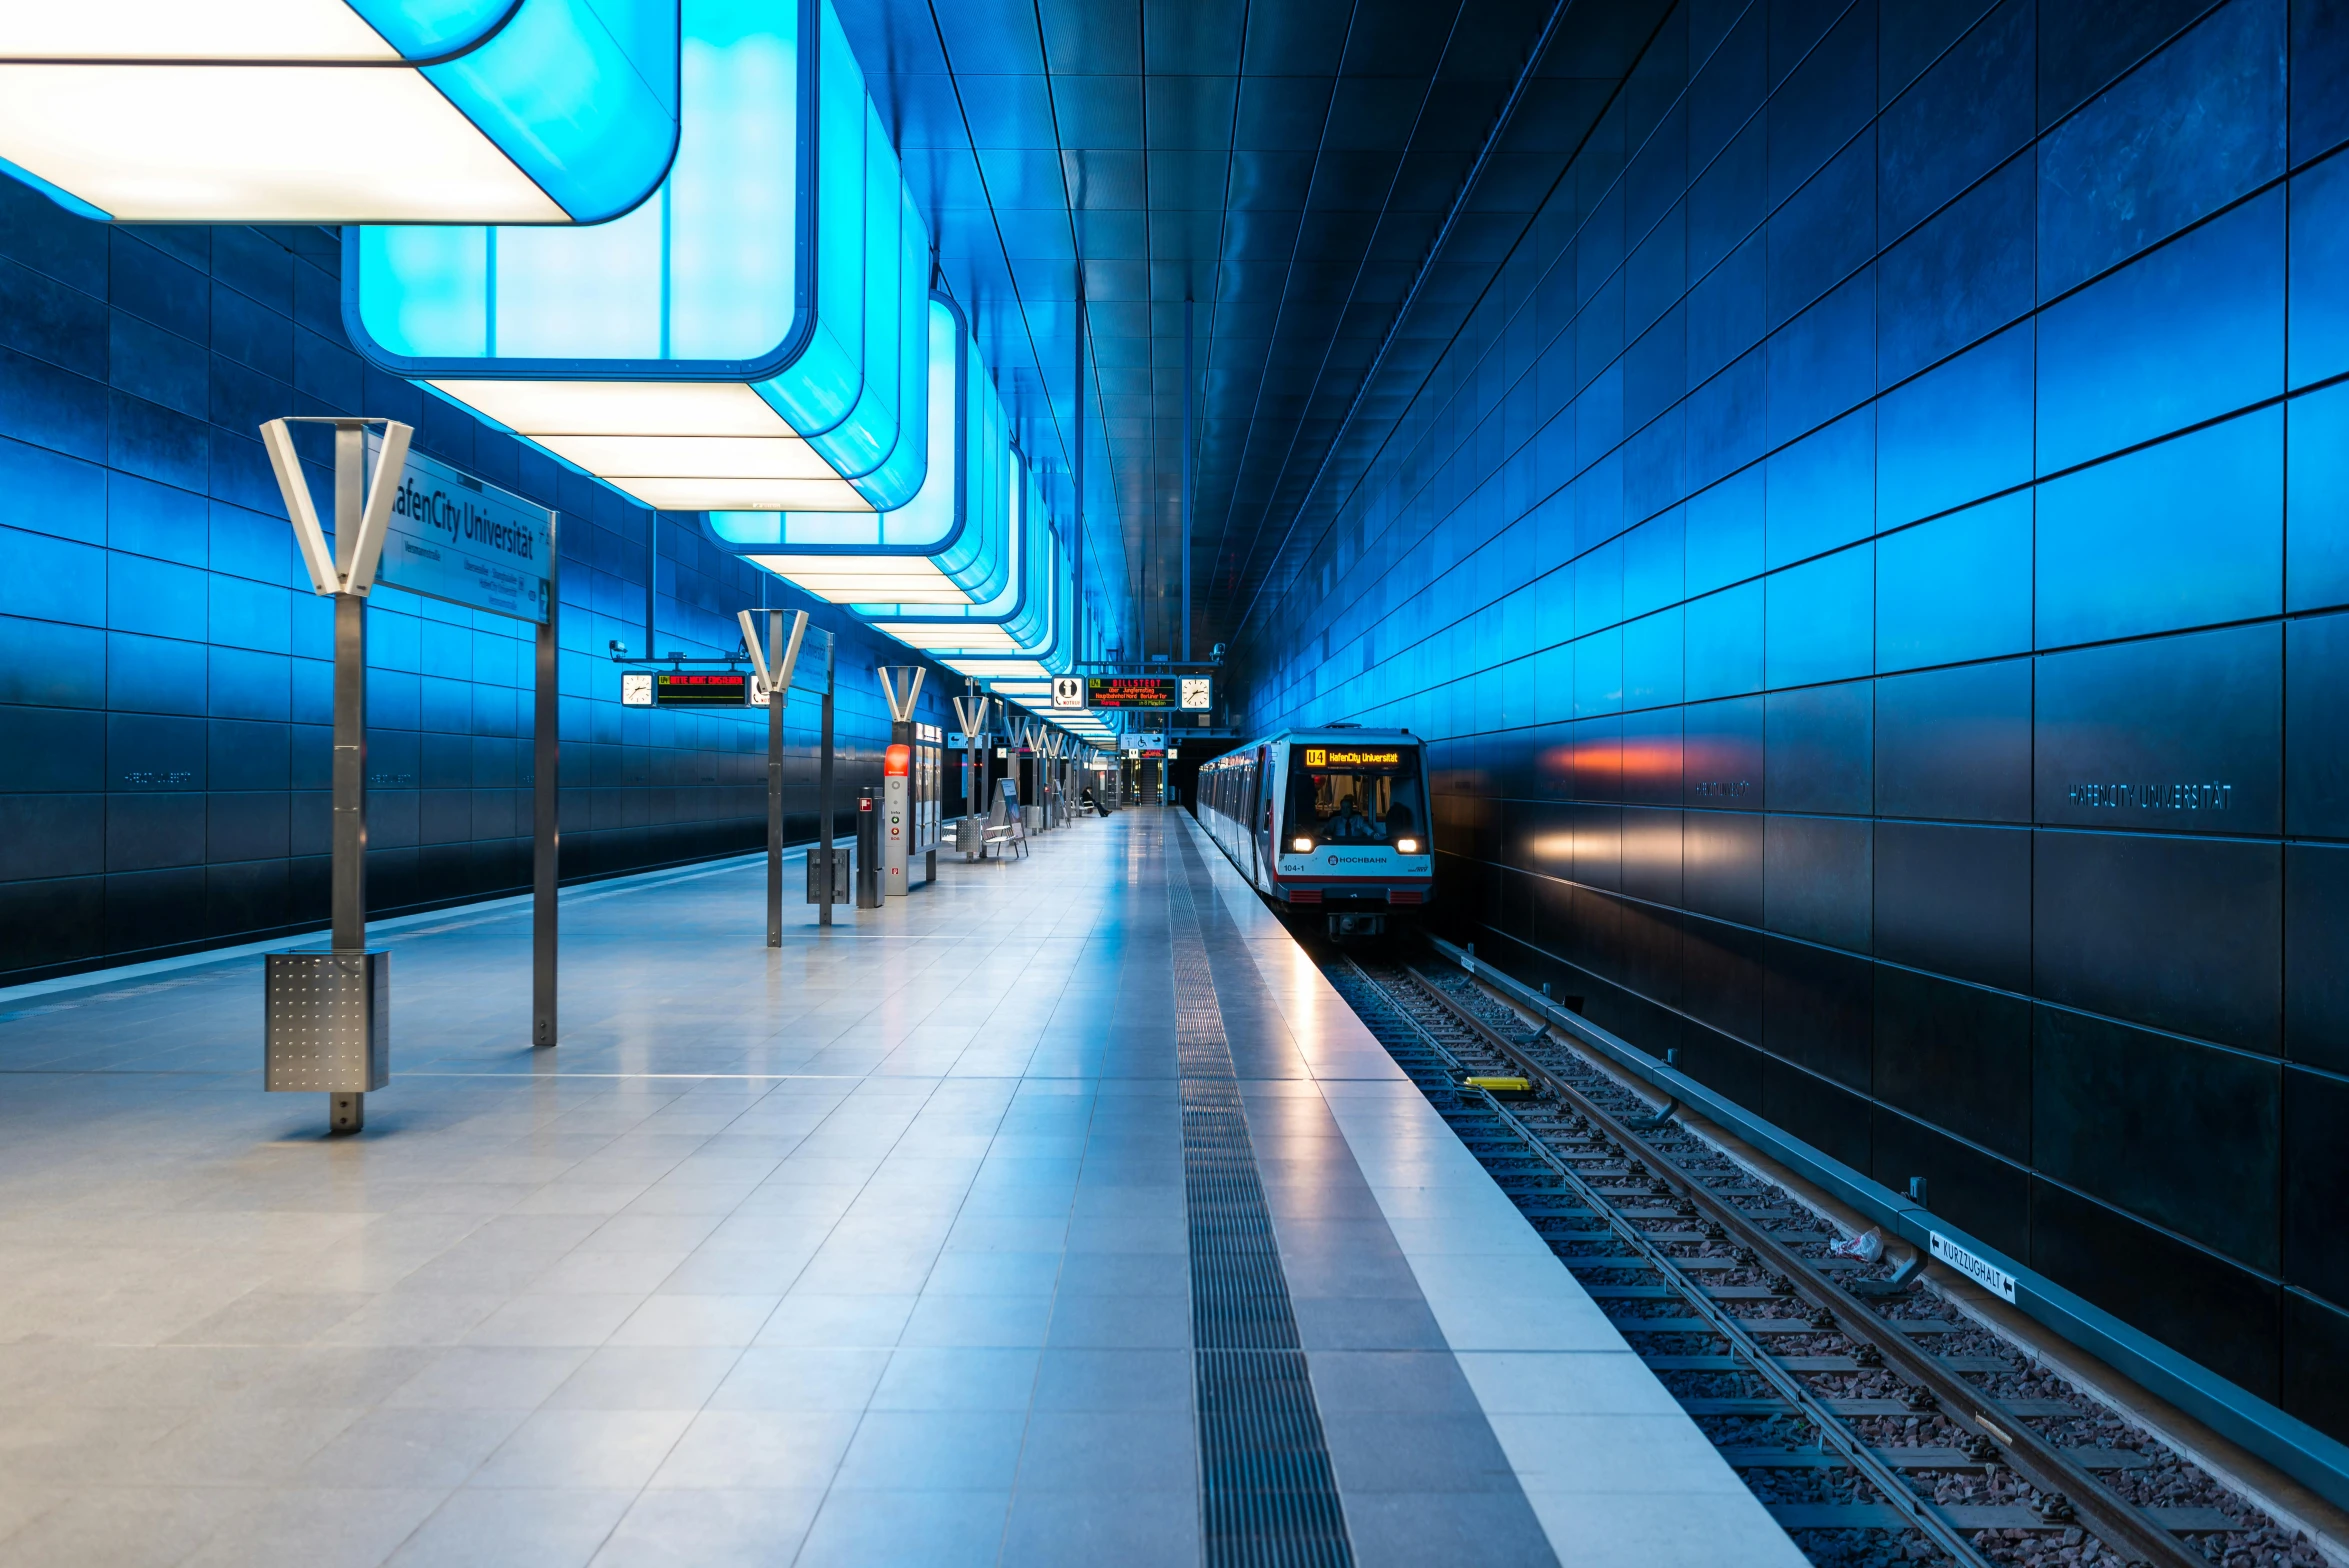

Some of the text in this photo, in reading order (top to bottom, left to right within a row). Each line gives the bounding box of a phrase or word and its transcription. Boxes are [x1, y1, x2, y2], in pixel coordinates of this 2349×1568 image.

[392, 477, 533, 561] afenCity Universität
[1112, 679, 1161, 687] BILLSTEDT
[1308, 751, 1398, 764] U4 HafenCity Universität
[2068, 780, 2232, 810] HAFENCITY UNIVERSITÄT
[1284, 864, 1304, 872] 104-1
[1943, 1239, 2001, 1290] KURZZUGHALT
